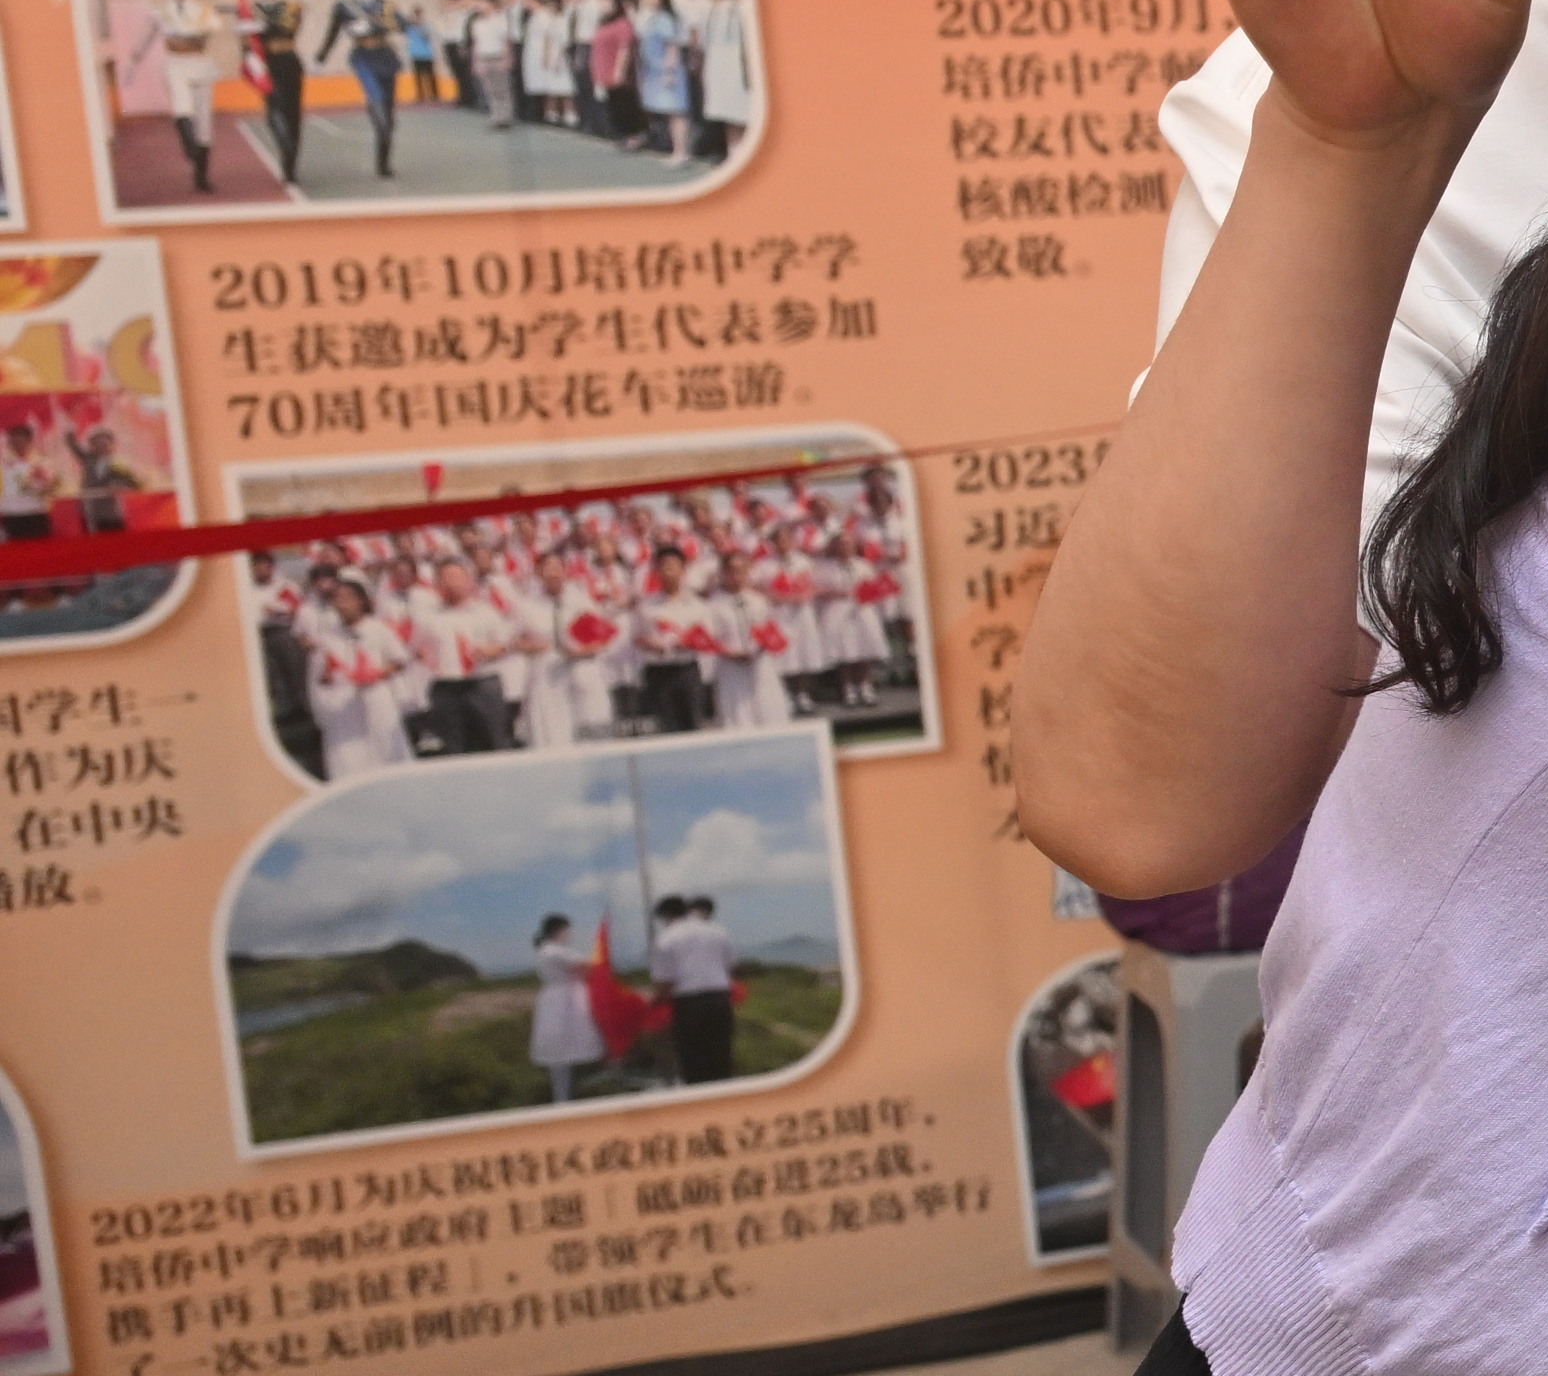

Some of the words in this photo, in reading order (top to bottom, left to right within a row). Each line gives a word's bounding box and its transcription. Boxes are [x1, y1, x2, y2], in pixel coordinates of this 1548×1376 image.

[211, 234, 862, 311] 2019年10月培侨中学学
[220, 296, 878, 376] 生获邀成为学生代表参加
[965, 508, 1072, 552] 习近
[17, 793, 183, 853] 在中央
